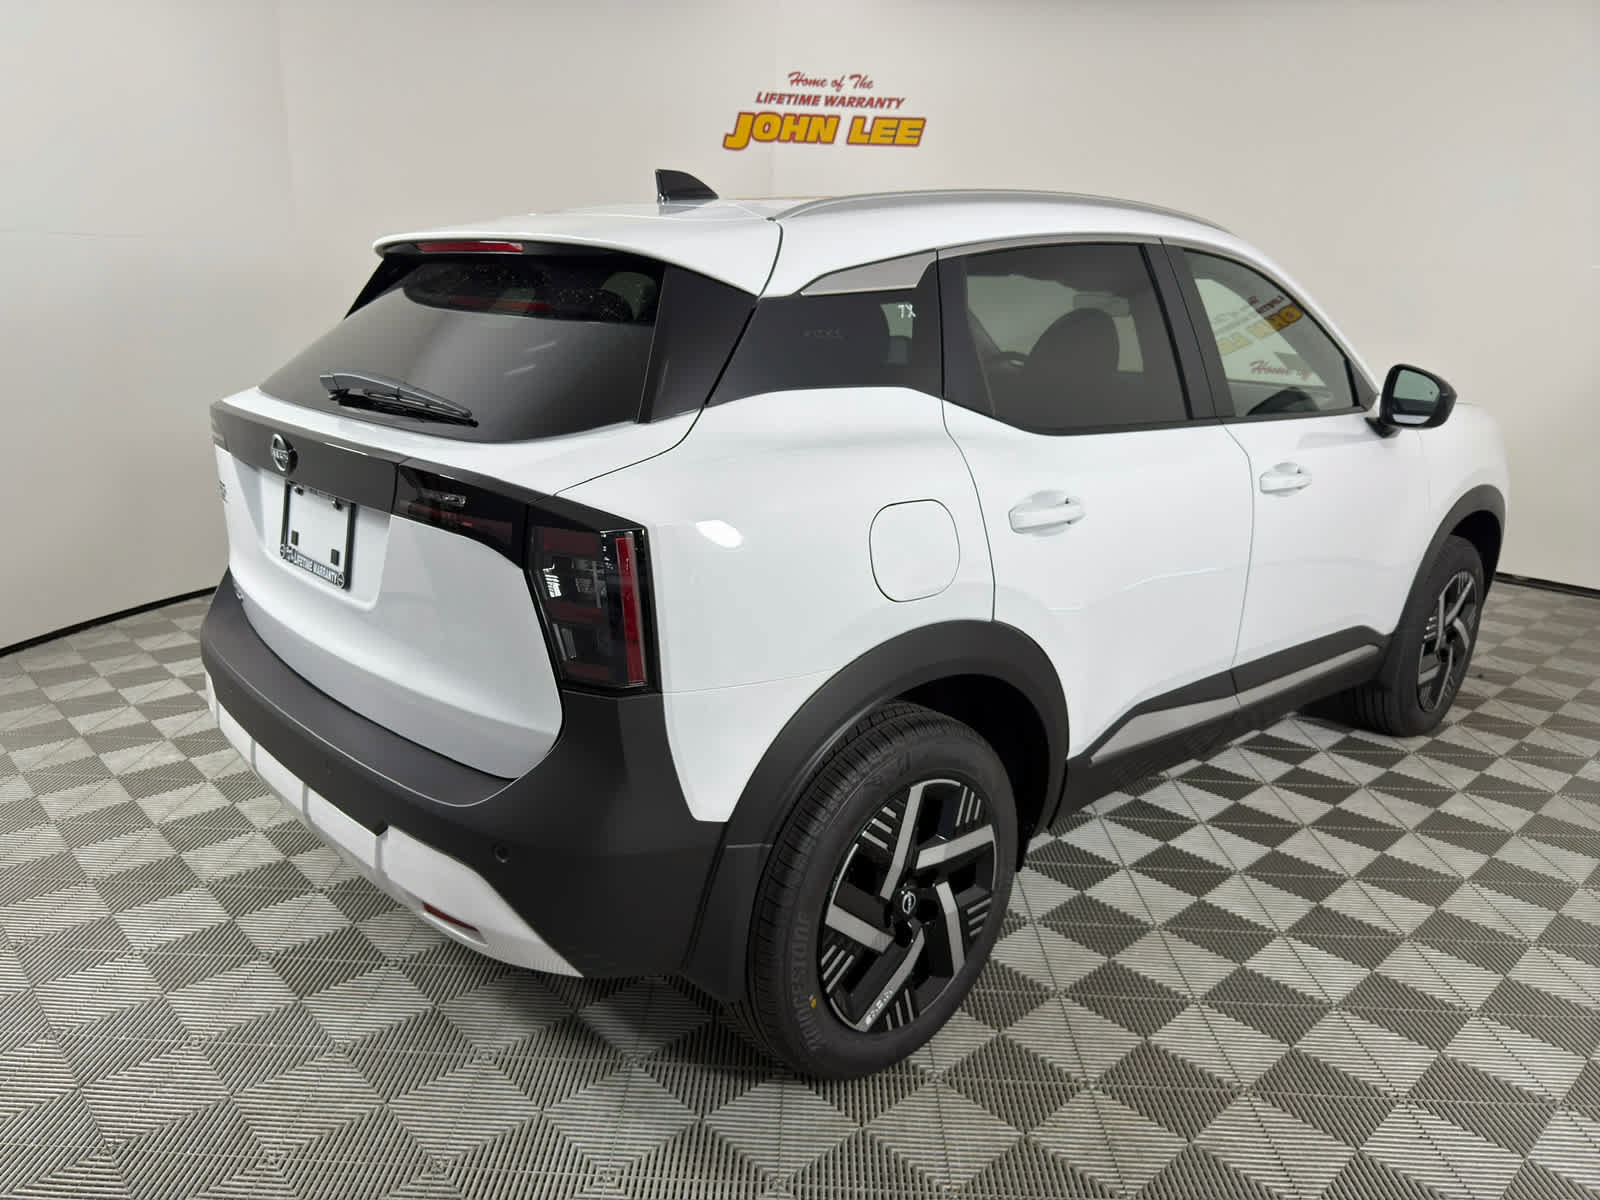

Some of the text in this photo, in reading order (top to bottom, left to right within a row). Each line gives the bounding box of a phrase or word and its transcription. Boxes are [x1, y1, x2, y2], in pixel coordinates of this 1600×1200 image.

[788, 71, 874, 91] Home of The
[755, 91, 906, 110] LIFETIME WARRANTY
[722, 111, 927, 151] JOHN LEE
